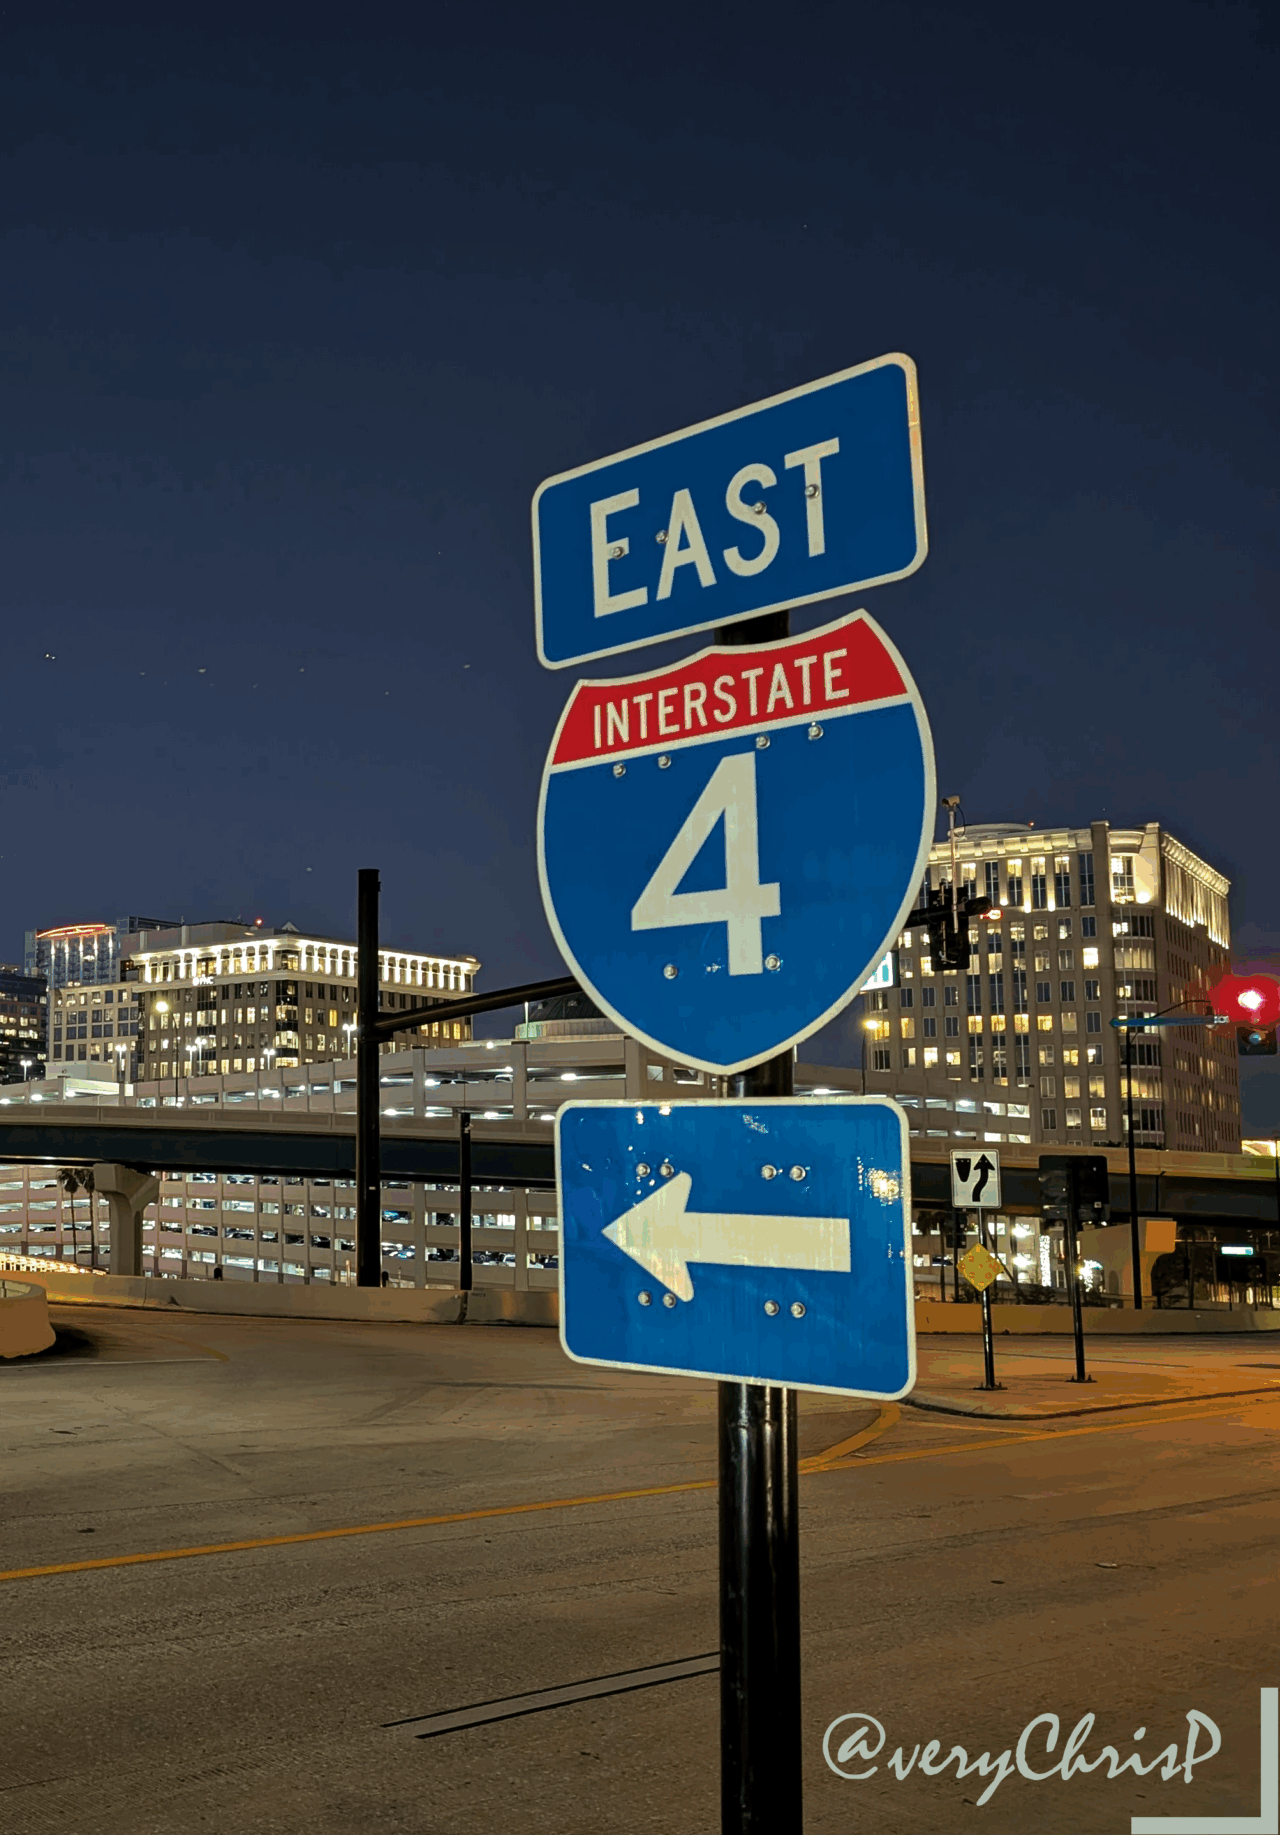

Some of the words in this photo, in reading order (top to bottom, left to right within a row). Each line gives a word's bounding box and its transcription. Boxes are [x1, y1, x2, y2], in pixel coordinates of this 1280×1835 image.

[590, 437, 839, 618] EAST
[593, 648, 850, 748] INTERSTATE
[631, 751, 781, 976] 4
